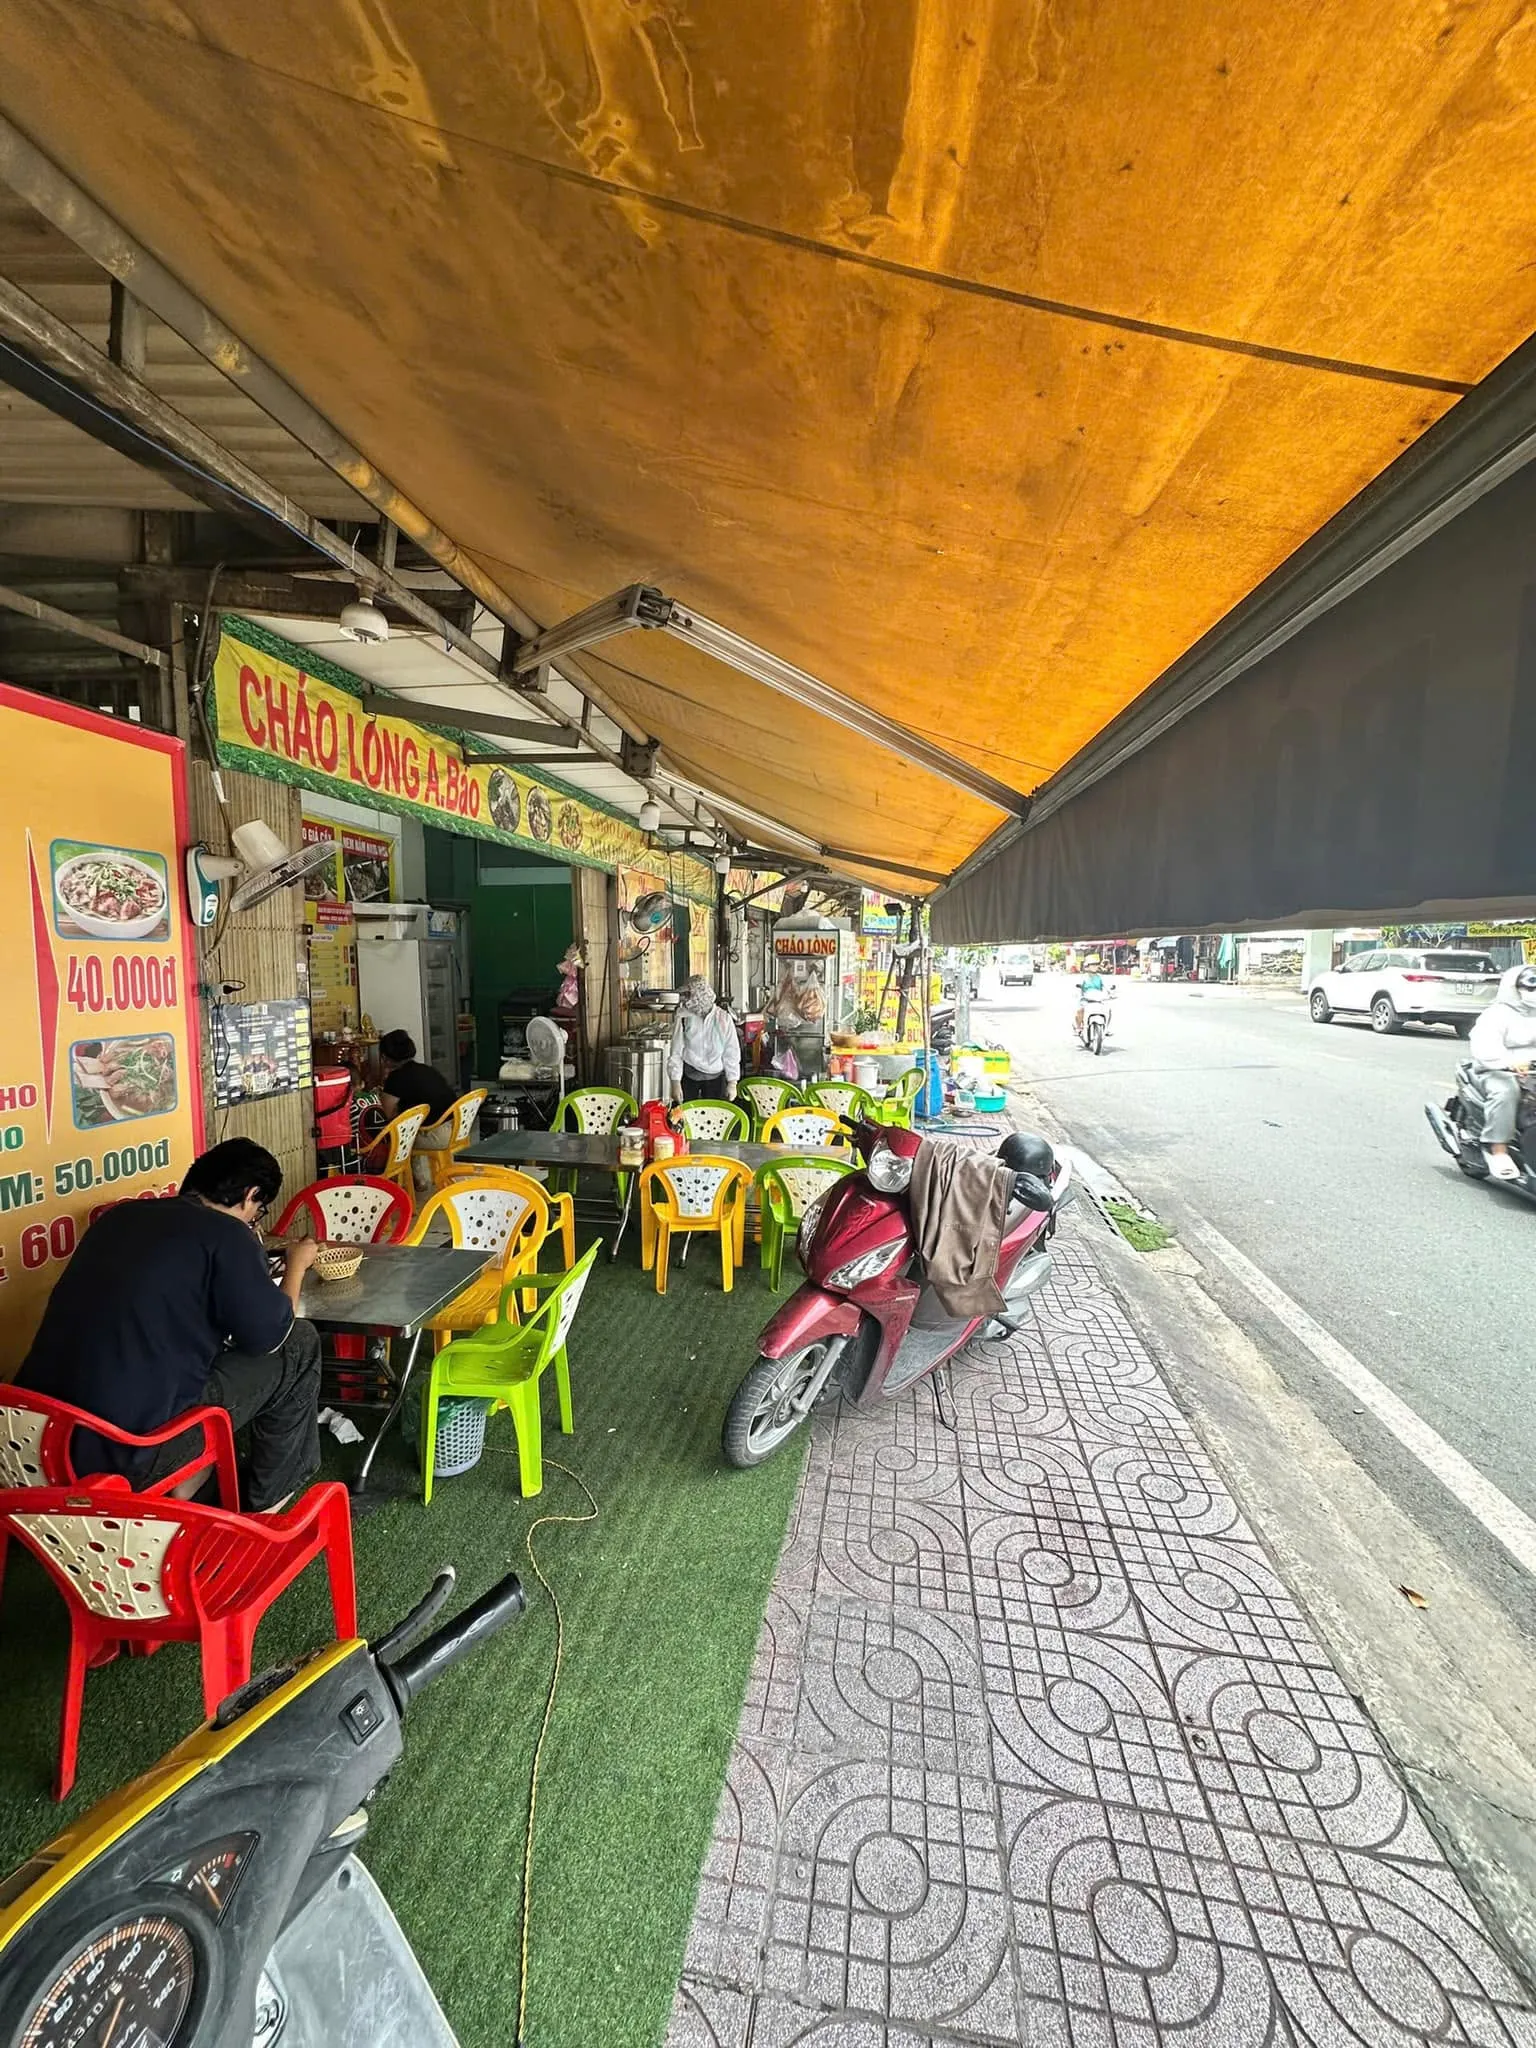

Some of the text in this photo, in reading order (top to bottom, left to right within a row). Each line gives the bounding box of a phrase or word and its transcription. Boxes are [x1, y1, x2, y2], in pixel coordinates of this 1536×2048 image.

[239, 664, 339, 774] CHÁO
[67, 955, 178, 1014] 40.000đ
[54, 1138, 170, 1196] 50.000đ
[117, 1941, 142, 1973] 100
[143, 1949, 168, 1979] 120
